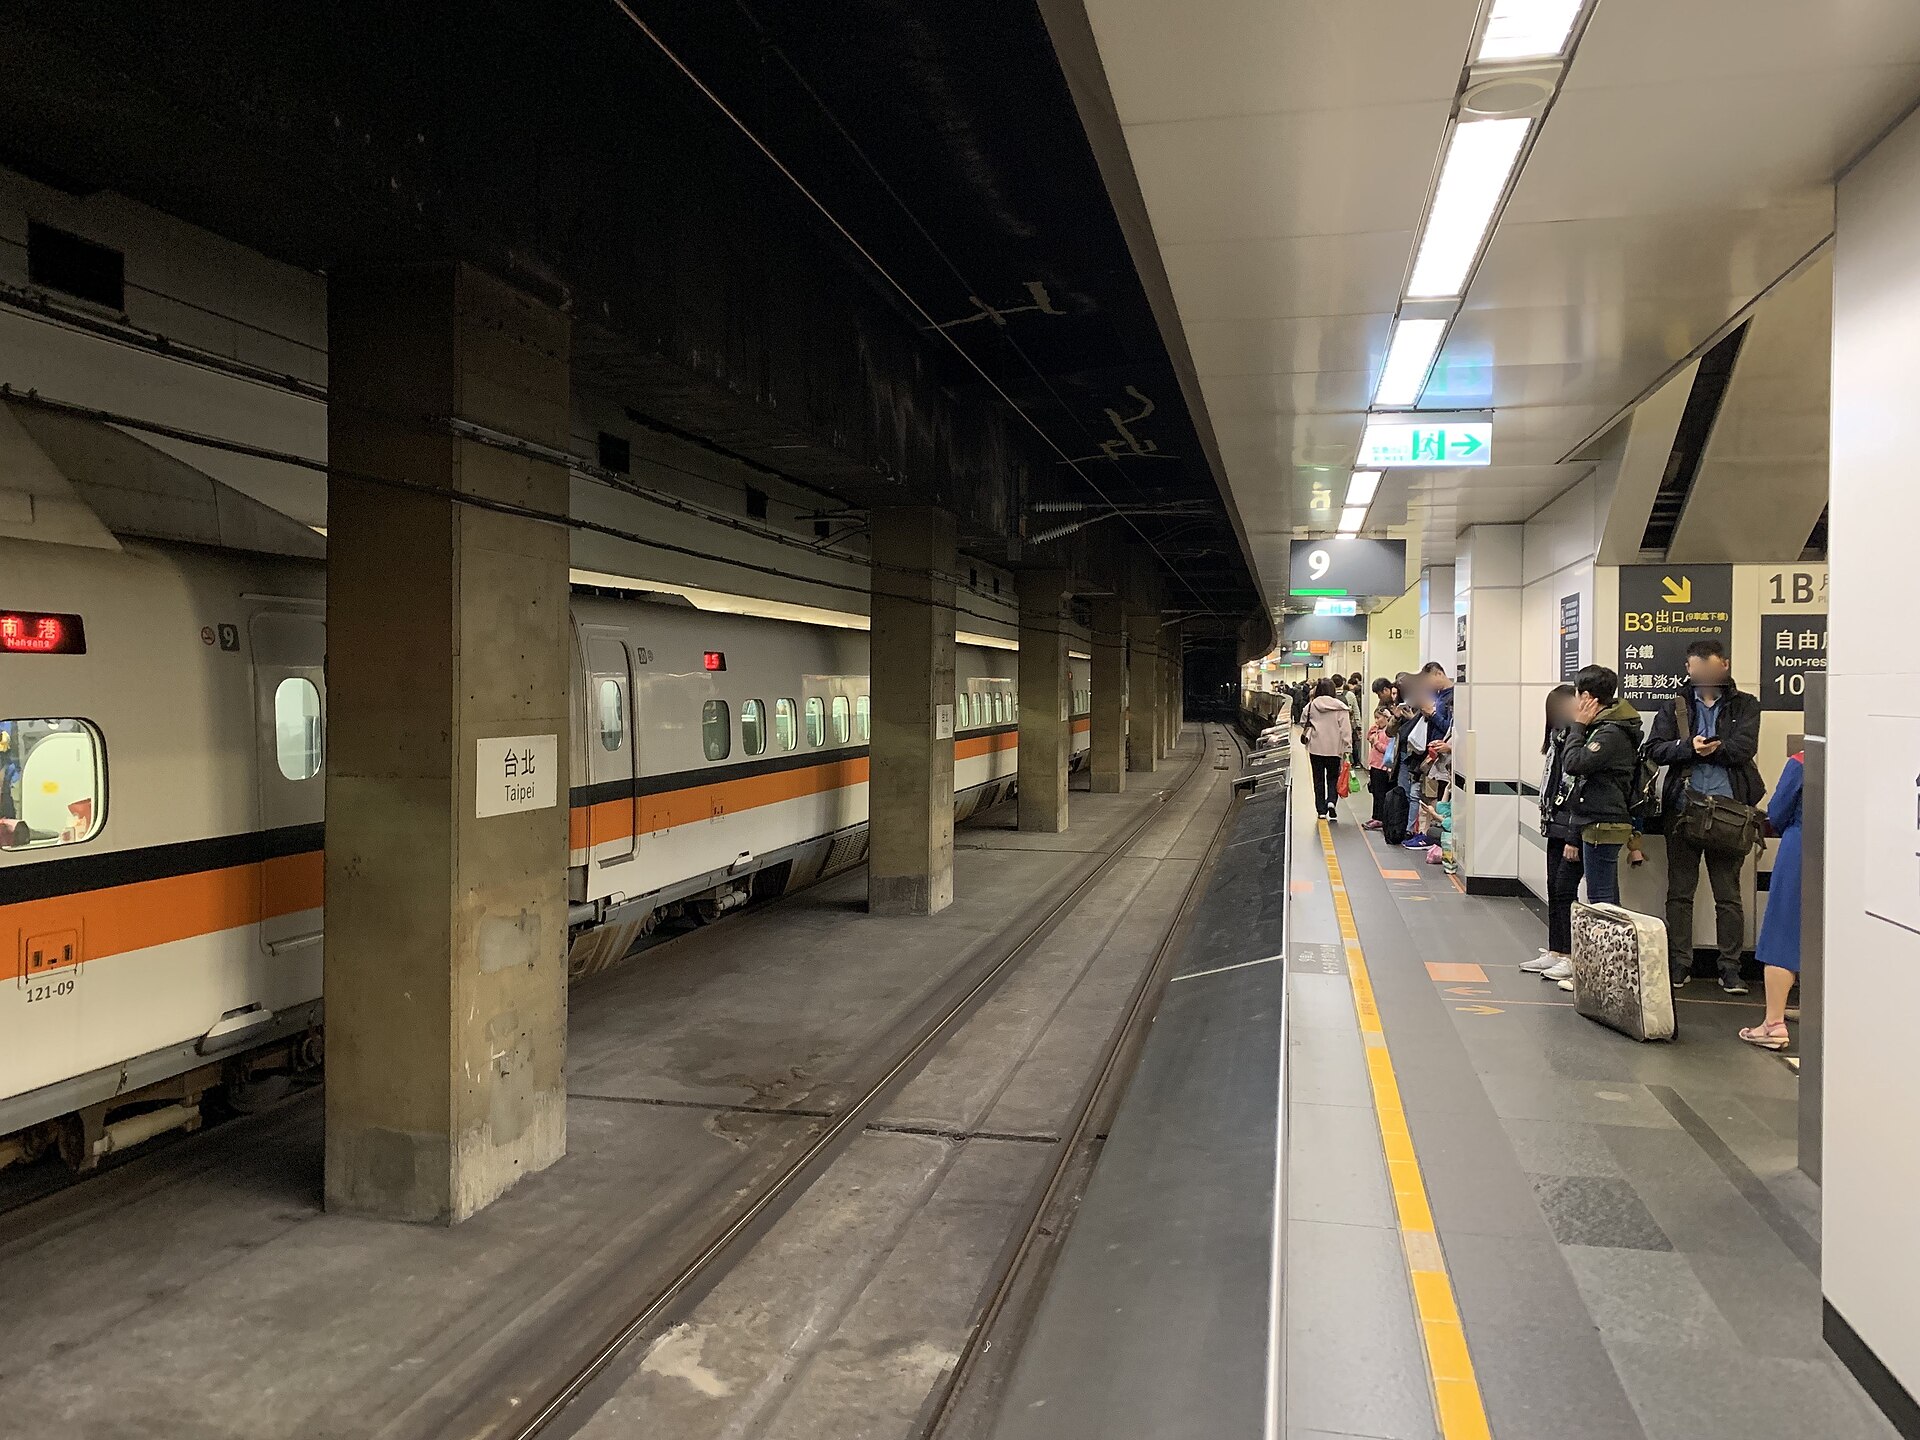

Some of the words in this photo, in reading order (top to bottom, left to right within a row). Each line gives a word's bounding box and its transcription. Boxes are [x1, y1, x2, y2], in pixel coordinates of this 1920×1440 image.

[1308, 550, 1330, 581] 9
[1769, 573, 1814, 604] 1B
[1624, 612, 1654, 632] B3
[1656, 609, 1684, 624] 出口
[1, 618, 56, 639] 南港
[222, 627, 234, 648] 9
[1388, 629, 1402, 639] 1B
[1656, 625, 1672, 633] Exit
[1295, 640, 1308, 651] 10
[1624, 662, 1644, 670] TRA
[1774, 674, 1805, 695] 10
[504, 748, 535, 778] 台北
[504, 782, 535, 803] Taipei
[26, 980, 75, 1003] 121-09
